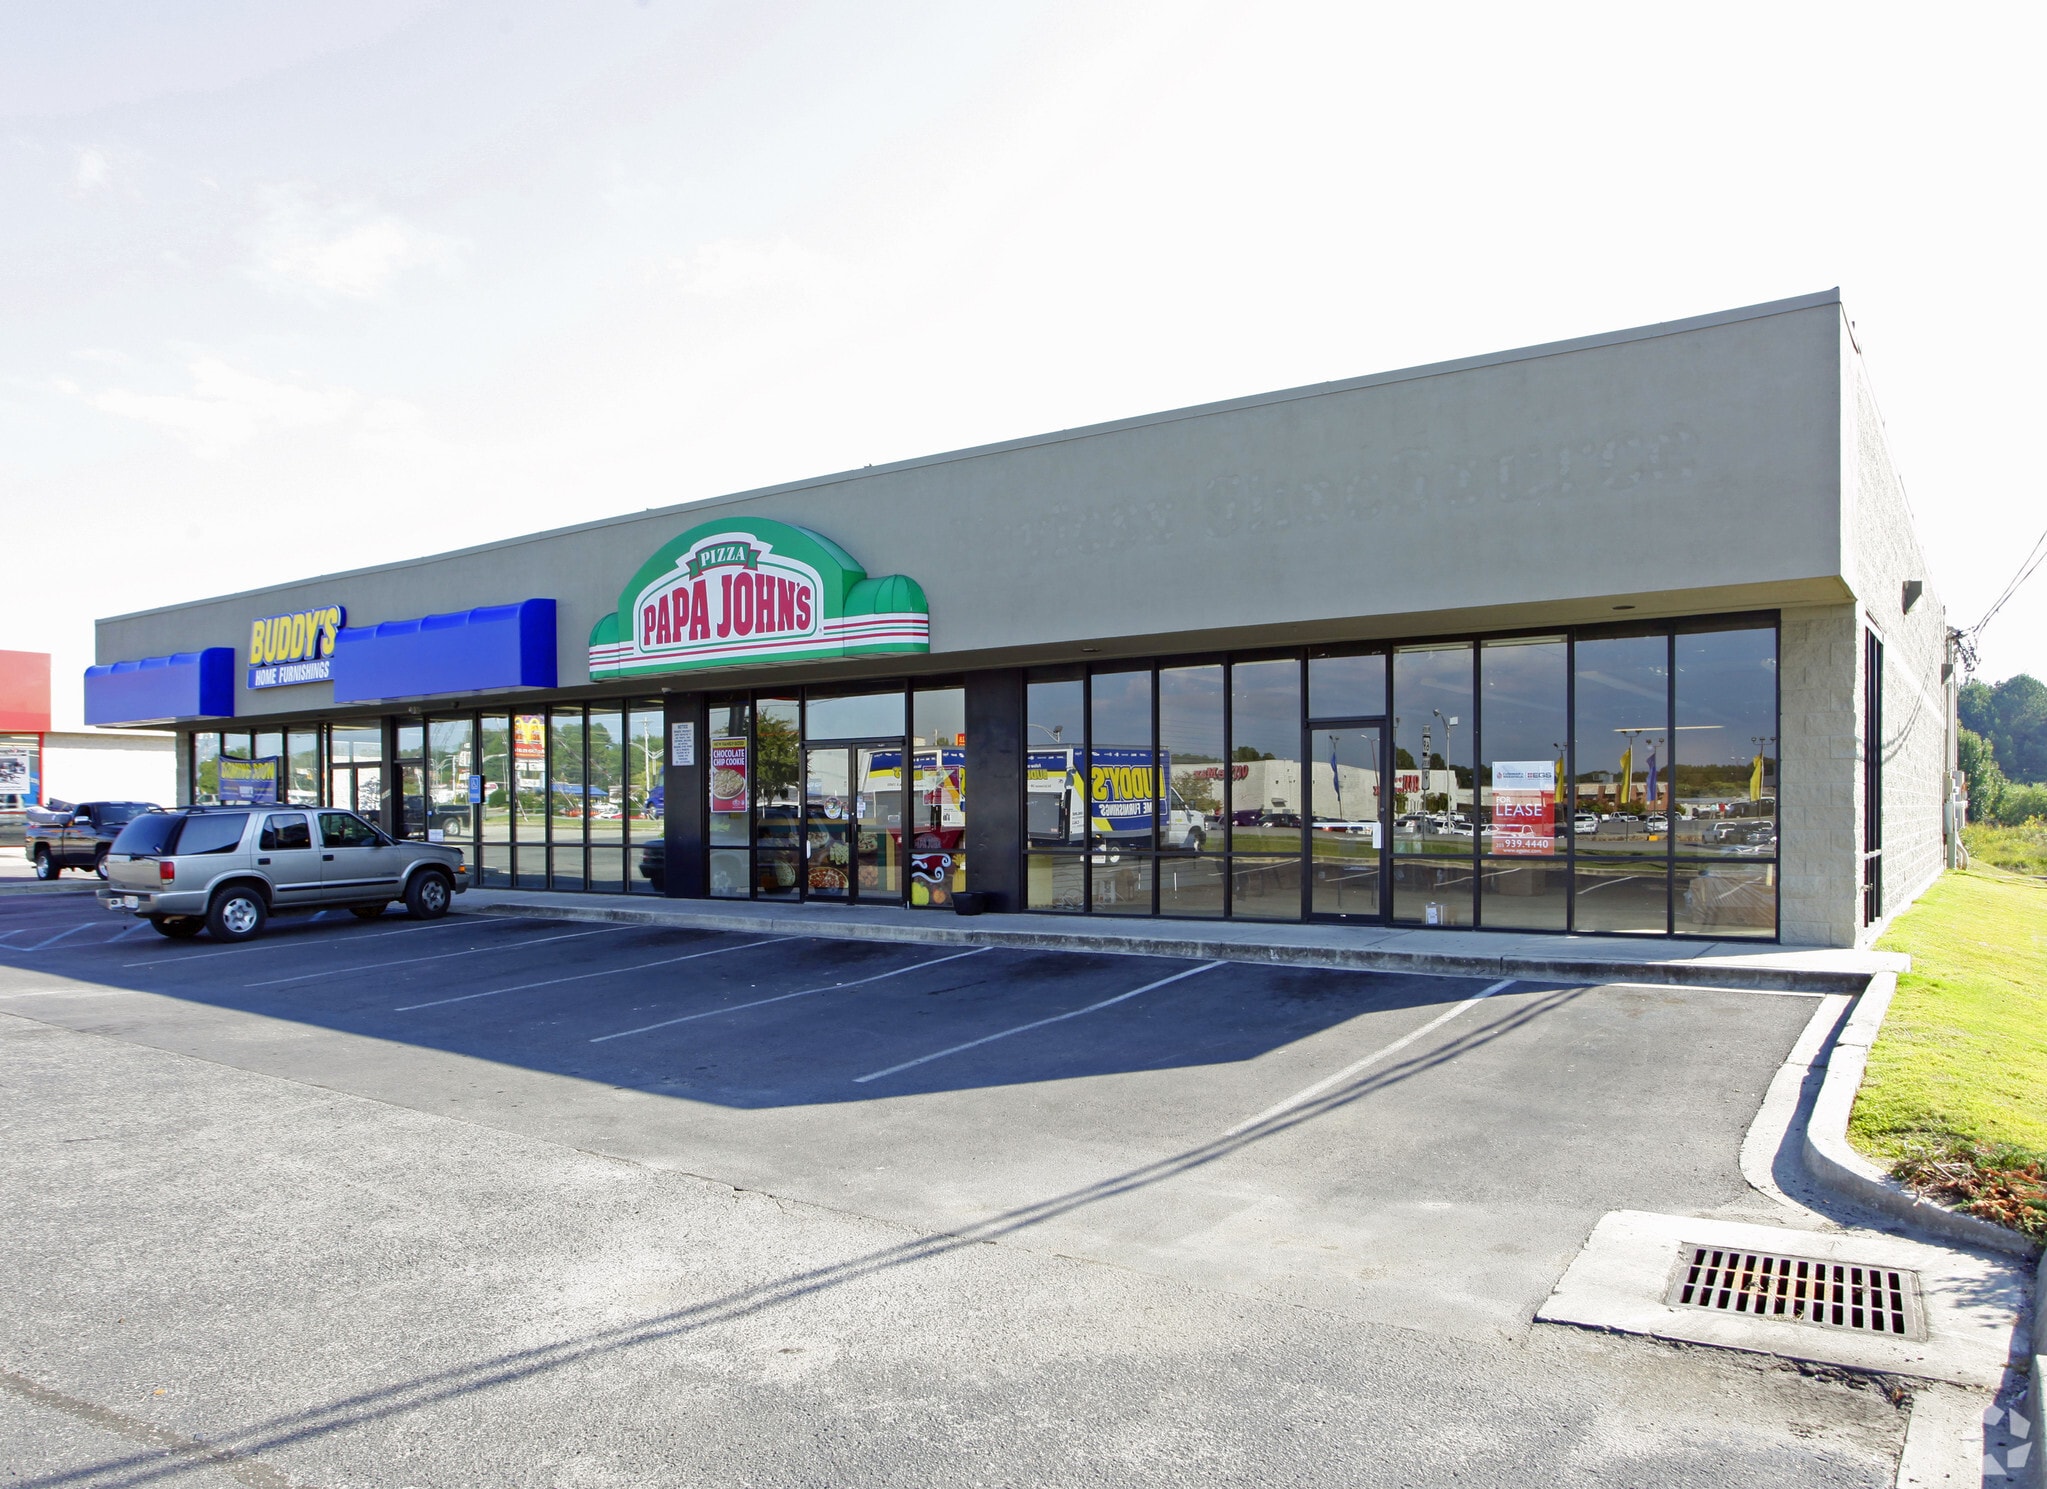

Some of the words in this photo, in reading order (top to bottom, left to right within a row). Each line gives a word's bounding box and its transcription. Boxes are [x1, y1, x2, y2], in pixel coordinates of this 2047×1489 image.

[700, 546, 746, 566] PIZZA
[643, 579, 711, 646] PAPA
[717, 571, 811, 638] JOHN'S
[249, 607, 338, 665] BUDDY'S
[255, 668, 277, 686] HOME
[278, 661, 330, 684] FURNISHINGS
[713, 749, 745, 758] CHOCOLATE
[713, 758, 725, 766] CHIP
[725, 758, 745, 766] COOKIE
[1495, 803, 1543, 817] LEASE
[1505, 839, 1549, 849] 939.4440
